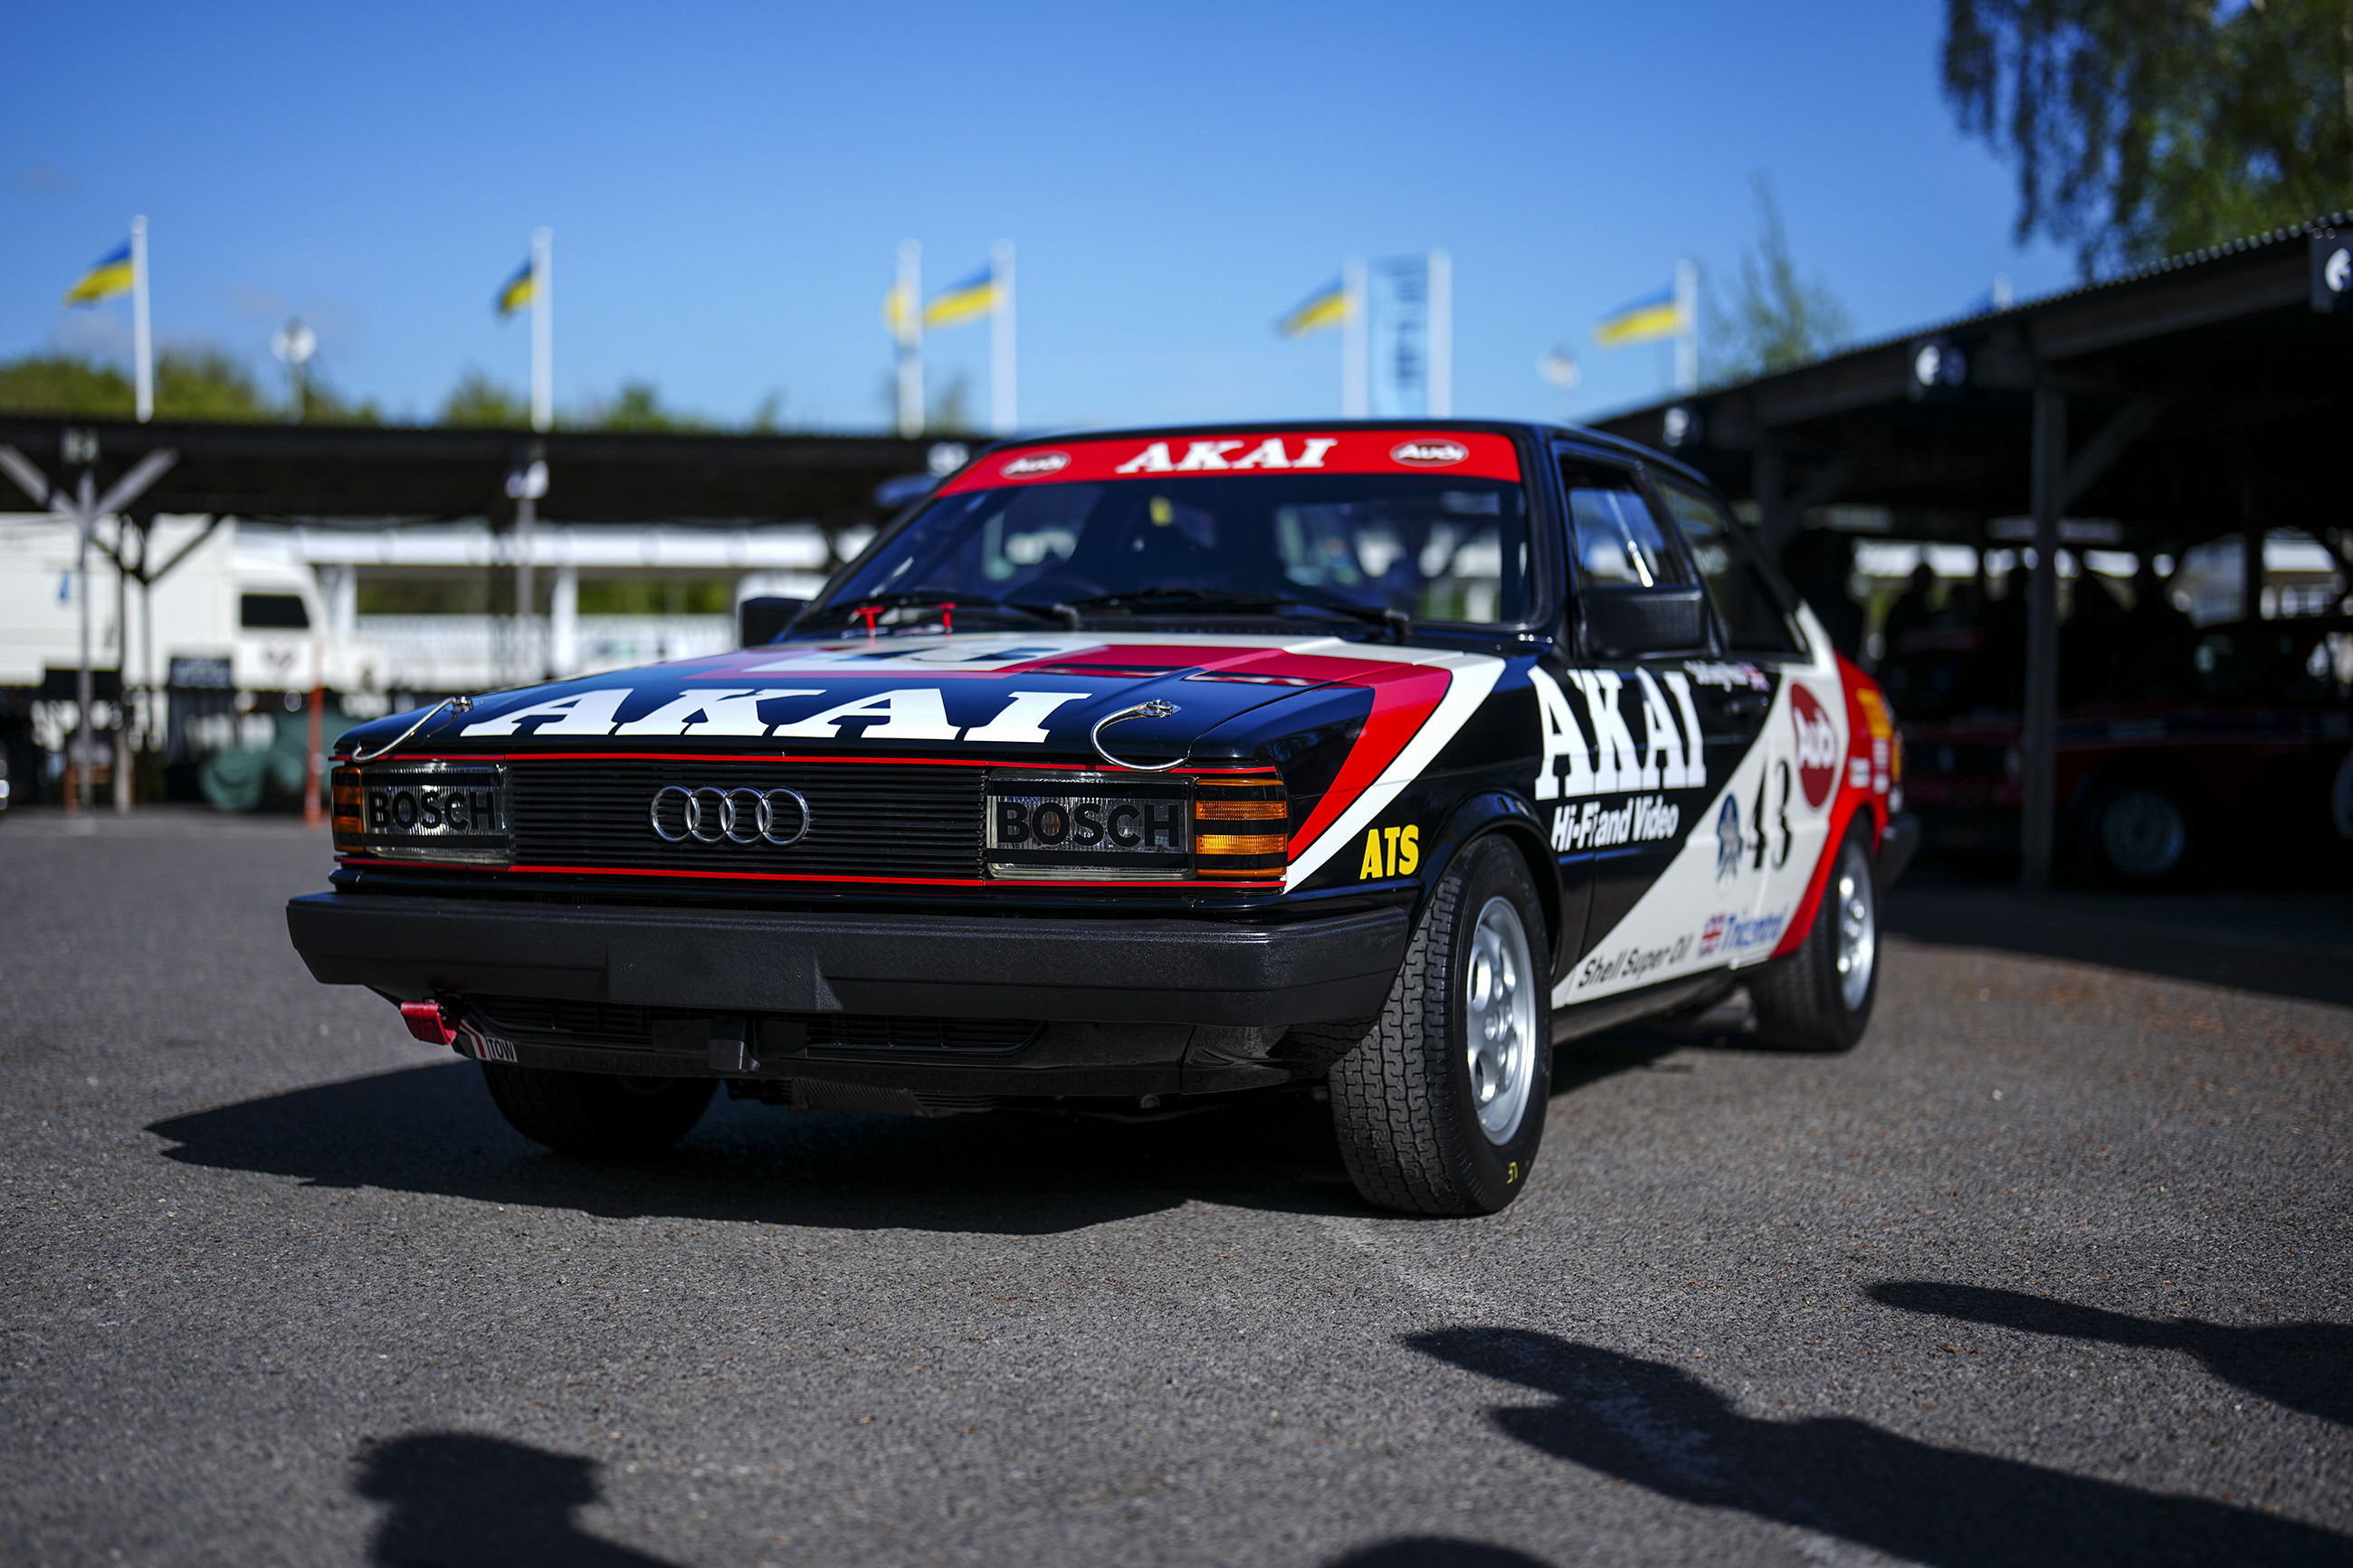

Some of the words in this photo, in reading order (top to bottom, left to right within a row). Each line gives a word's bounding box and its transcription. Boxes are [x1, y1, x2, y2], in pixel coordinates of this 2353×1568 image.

[1115, 438, 1338, 474] AKAI
[1394, 443, 1465, 461] Audi
[460, 689, 1091, 743] AKAI
[1528, 665, 1707, 801] AKAI
[368, 790, 496, 831] BOSCH
[996, 801, 1180, 849] BOSCH
[1550, 801, 1601, 853] Hi-Fi
[1594, 797, 1634, 848] and
[1632, 794, 1680, 842] Video
[1747, 756, 1792, 871] 43
[1359, 825, 1419, 879] ATS
[1577, 949, 1628, 989] Shell
[1622, 946, 1670, 981] Super
[1669, 933, 1695, 965] Oil
[487, 1039, 515, 1061] TOW
